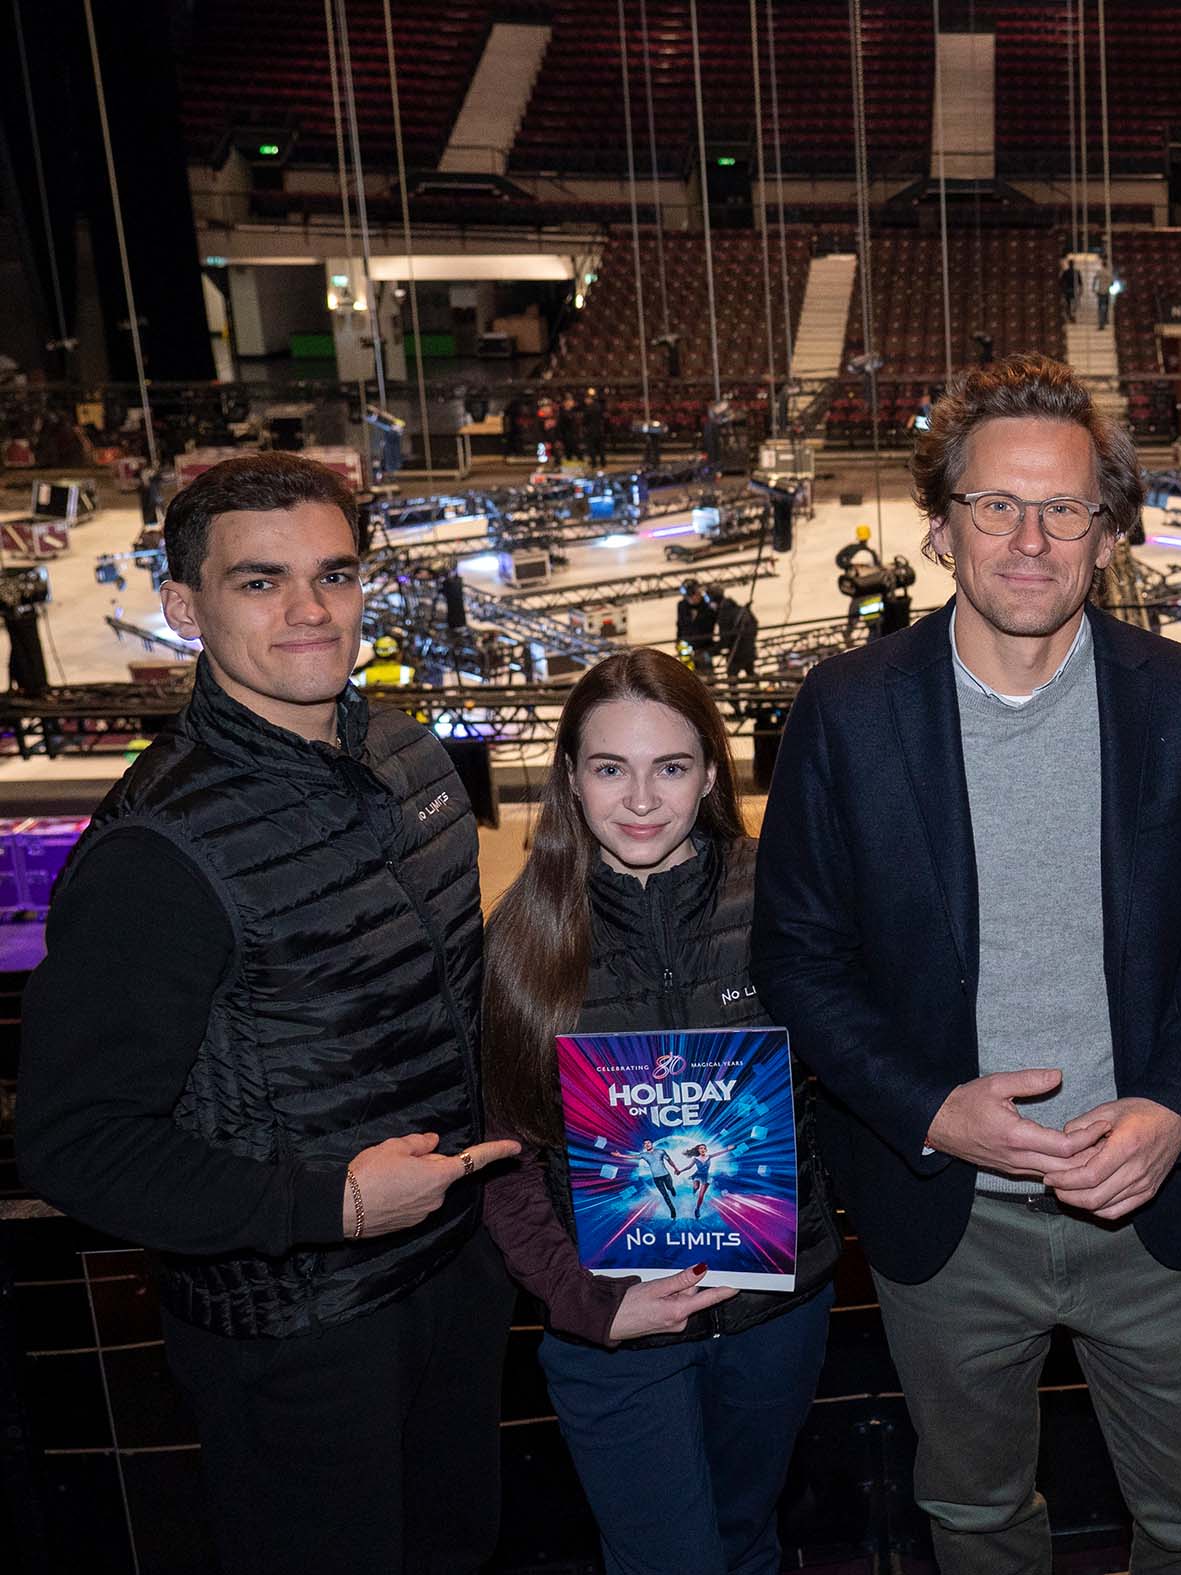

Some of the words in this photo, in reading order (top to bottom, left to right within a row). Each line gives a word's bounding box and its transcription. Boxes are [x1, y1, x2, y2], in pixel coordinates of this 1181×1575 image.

[424, 791, 449, 815] LIMITS
[596, 1064, 650, 1072] CELEBRATING
[652, 1051, 687, 1080] 80
[608, 1079, 737, 1107] HOLIDAY
[629, 1106, 647, 1116] ON
[650, 1104, 704, 1128] ICE
[666, 1232, 741, 1250] LIMITS
